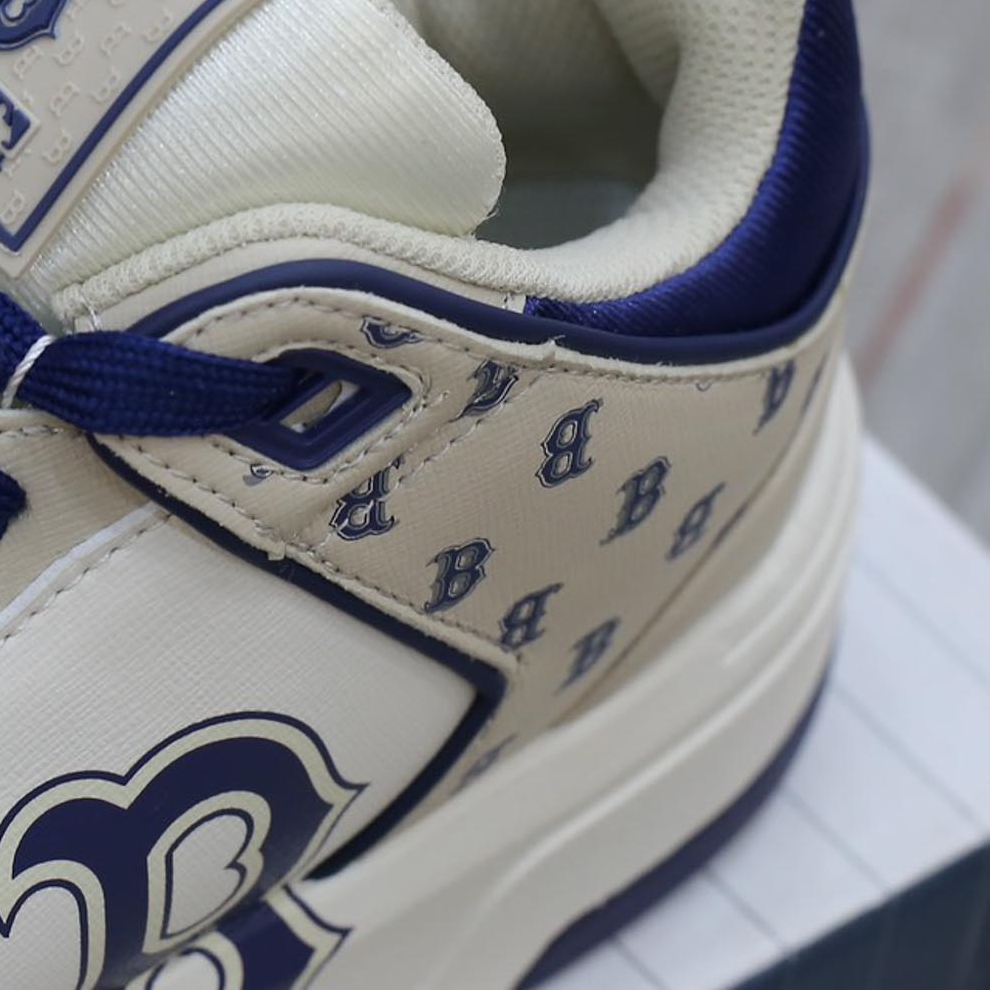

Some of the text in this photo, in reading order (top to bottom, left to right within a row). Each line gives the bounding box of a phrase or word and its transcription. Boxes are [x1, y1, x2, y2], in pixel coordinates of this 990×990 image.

[535, 398, 603, 488] B
[602, 456, 672, 544] B
[424, 537, 496, 614] B
[499, 583, 565, 652] B
